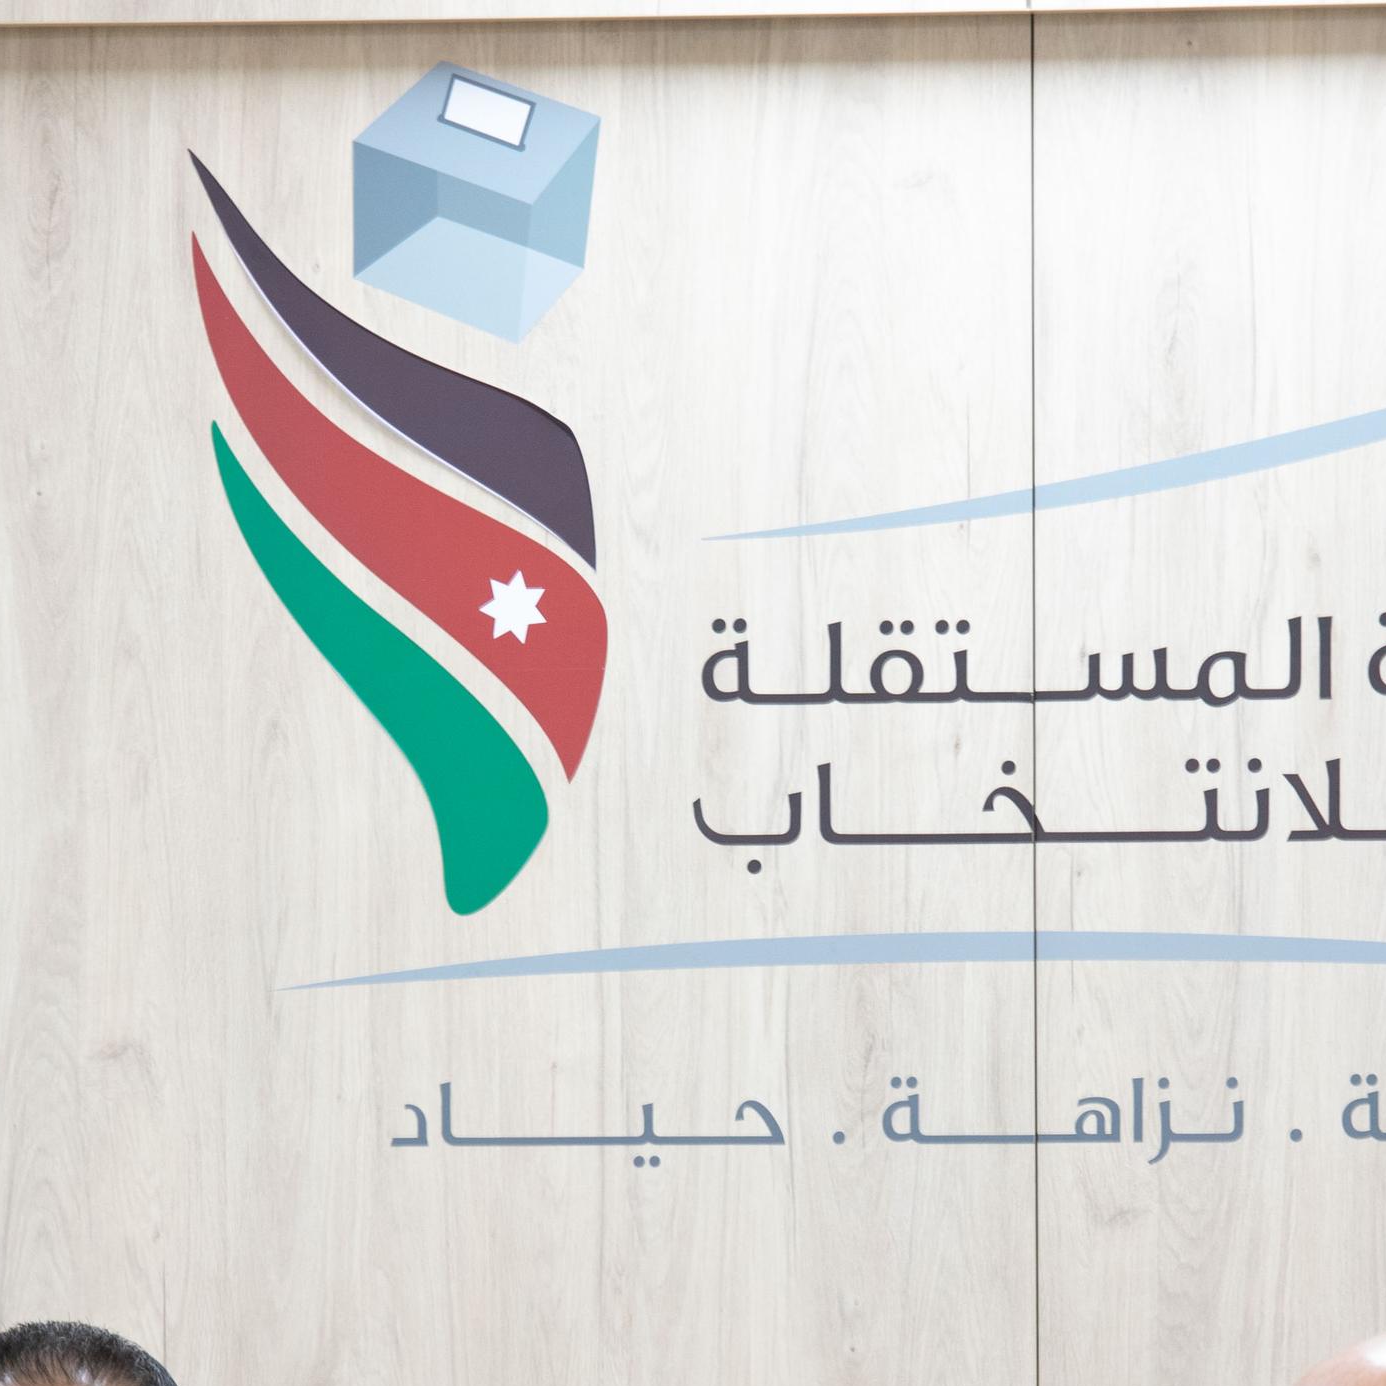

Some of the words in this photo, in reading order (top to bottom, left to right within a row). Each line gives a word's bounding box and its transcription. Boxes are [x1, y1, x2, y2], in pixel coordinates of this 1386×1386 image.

[702, 616, 1333, 708] المستقلة
[392, 1082, 785, 1168] حياد
[882, 1076, 1245, 1163] نزاهة
